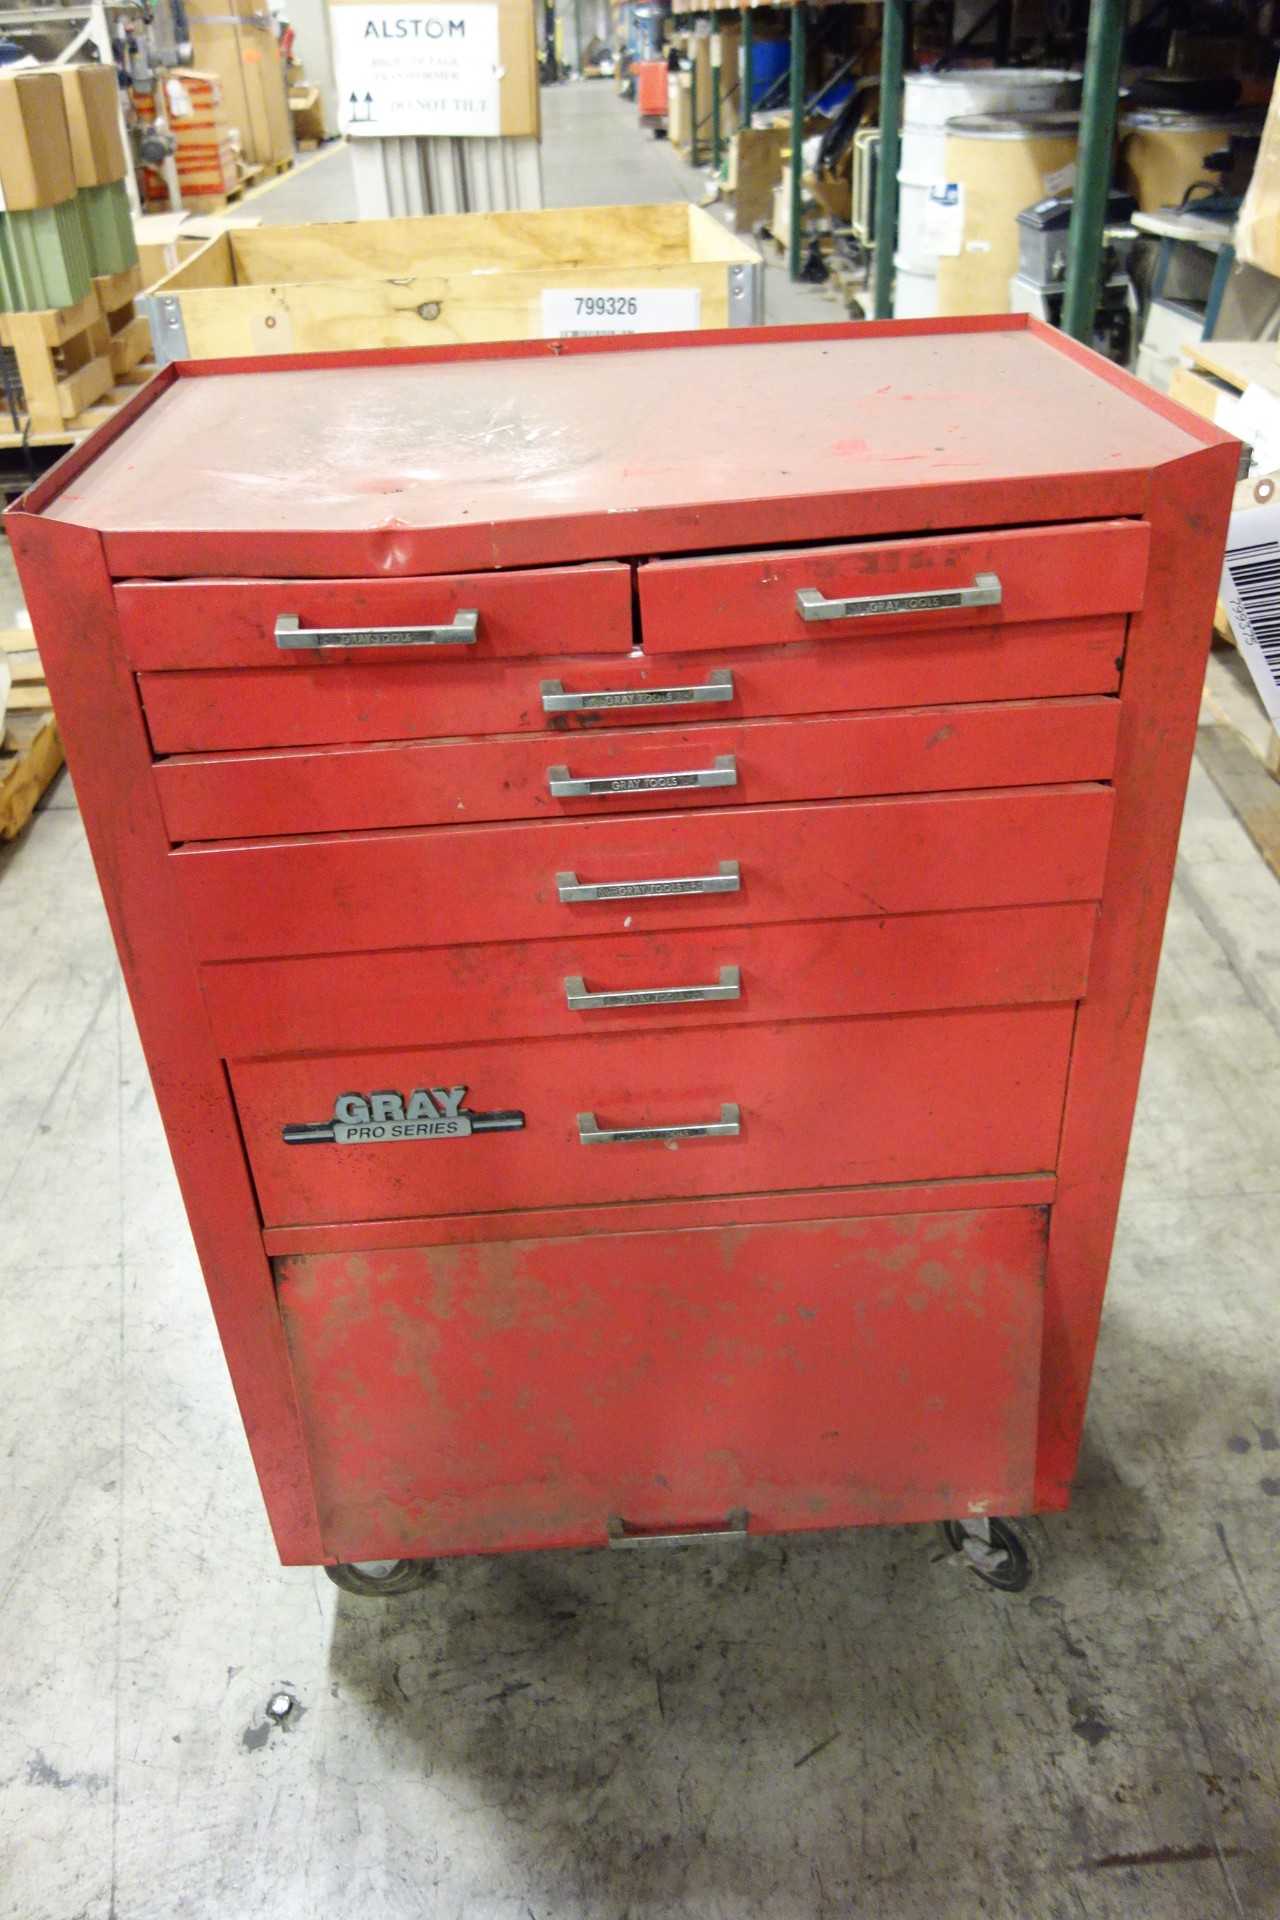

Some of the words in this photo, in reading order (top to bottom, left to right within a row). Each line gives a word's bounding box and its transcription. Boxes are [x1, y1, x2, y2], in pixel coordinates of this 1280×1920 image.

[364, 18, 466, 39] ALSTOM
[416, 97, 447, 112] NOT
[575, 297, 637, 315] 799326
[870, 601, 900, 612] GRAY
[903, 597, 940, 609] TOOLS
[607, 695, 635, 705] GRAY
[611, 779, 640, 791] GRAY
[644, 776, 678, 788] TOOLS
[618, 886, 646, 896] GRAY
[335, 1086, 468, 1124] GRAY
[347, 1126, 386, 1140] PRO
[391, 1122, 458, 1137] SERIES
